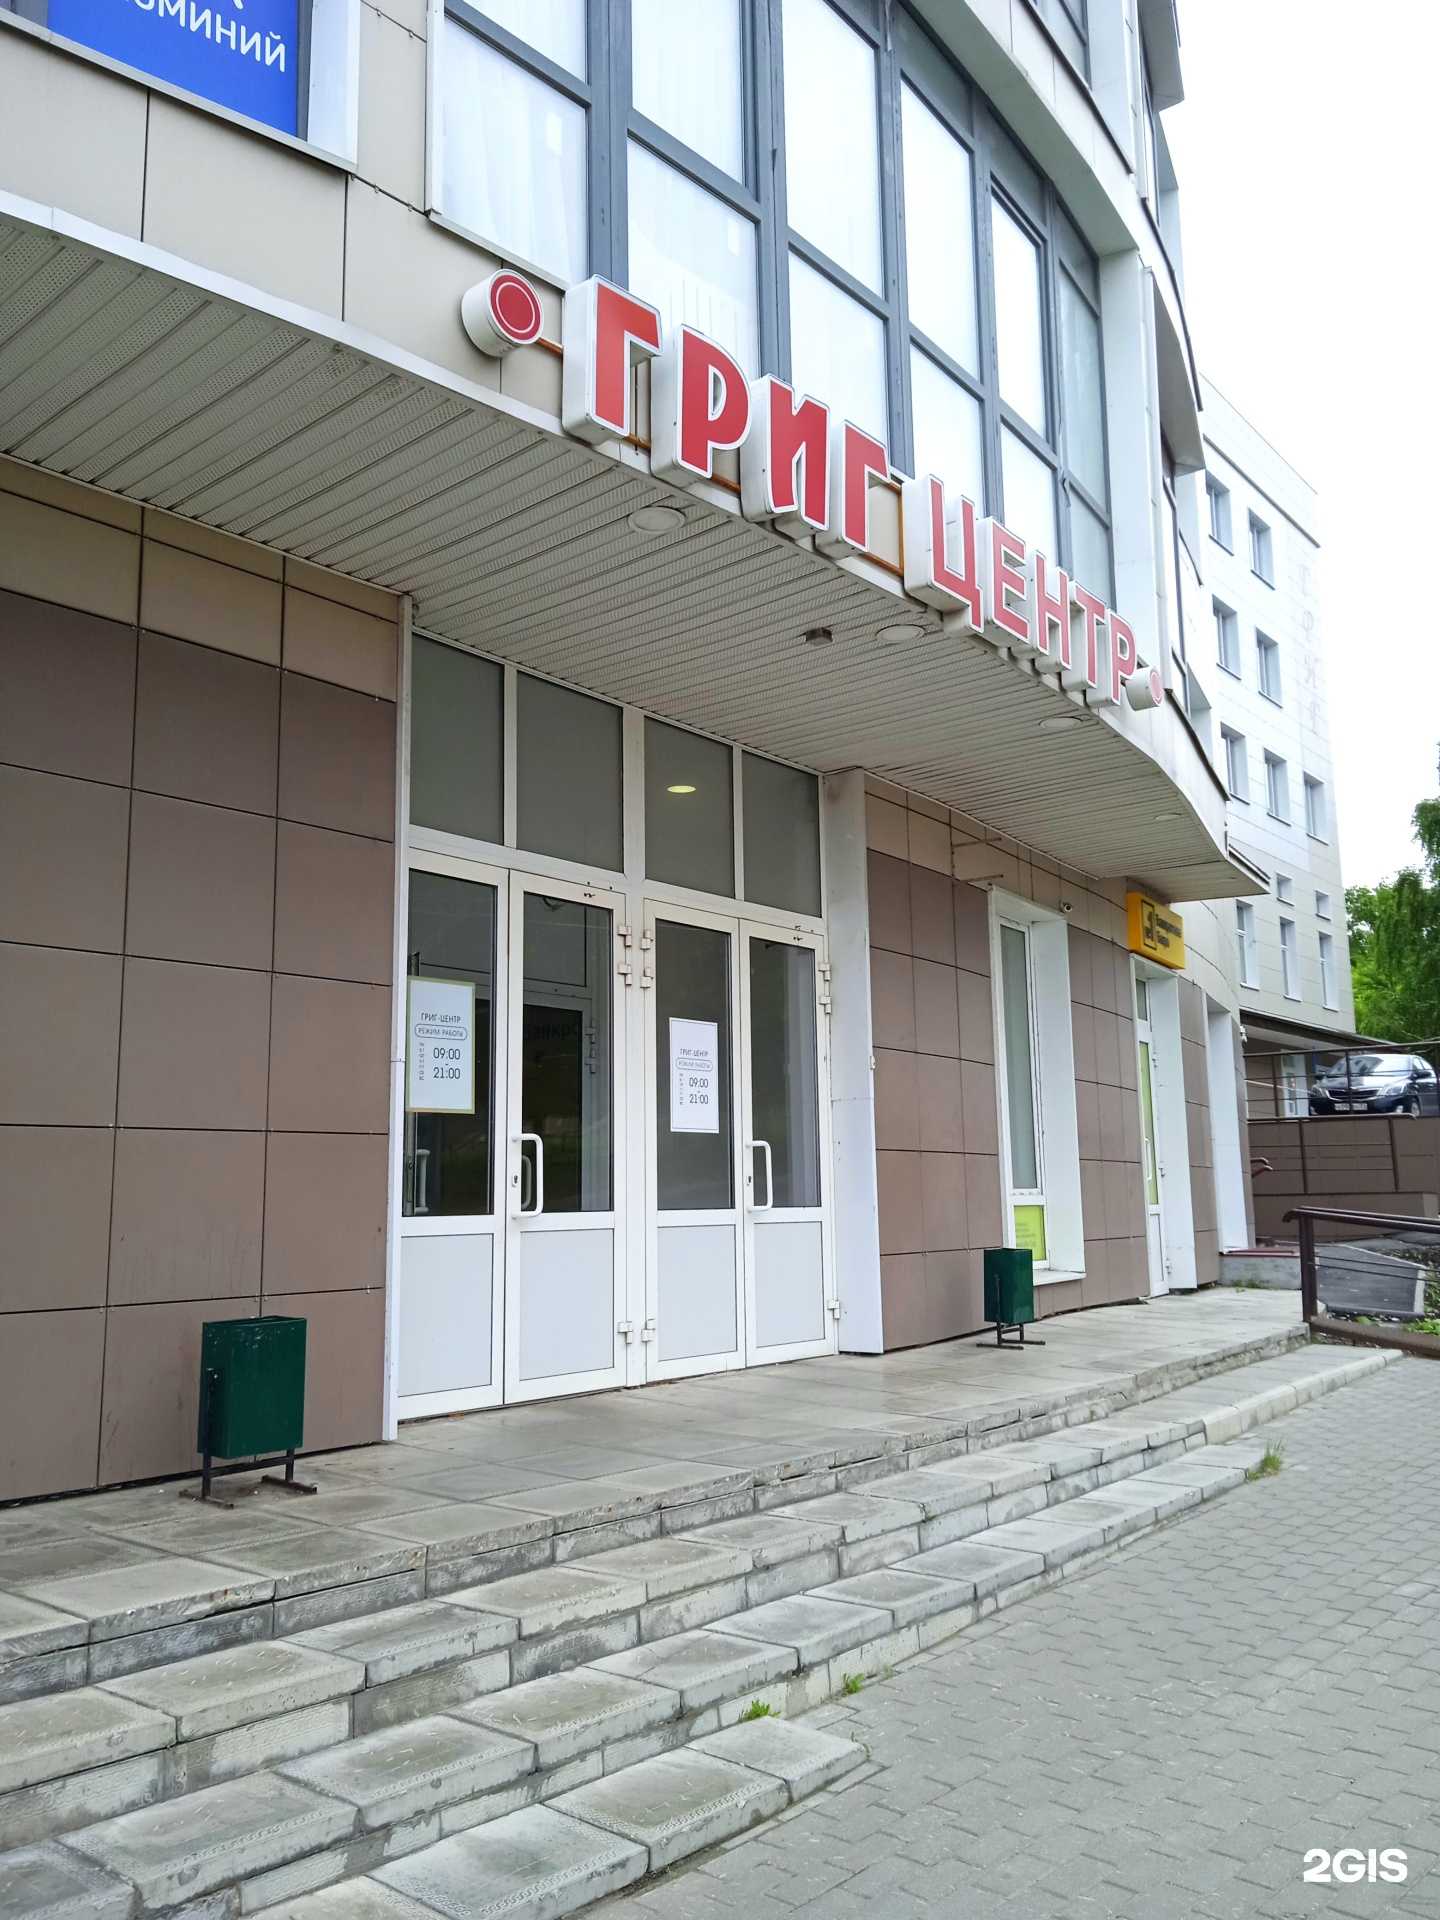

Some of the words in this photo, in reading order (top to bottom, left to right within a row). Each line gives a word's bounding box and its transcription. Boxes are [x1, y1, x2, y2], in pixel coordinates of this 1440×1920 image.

[592, 275, 892, 554] ГРИГ
[927, 474, 1138, 706] ЦЕНТР
[420, 1012, 462, 1023] ГРИГ-ЦЕНТР
[432, 1047, 461, 1060] 09:00
[432, 1066, 461, 1079] 21:00
[688, 1077, 709, 1088] 09:00
[688, 1093, 709, 1104] 21:00
